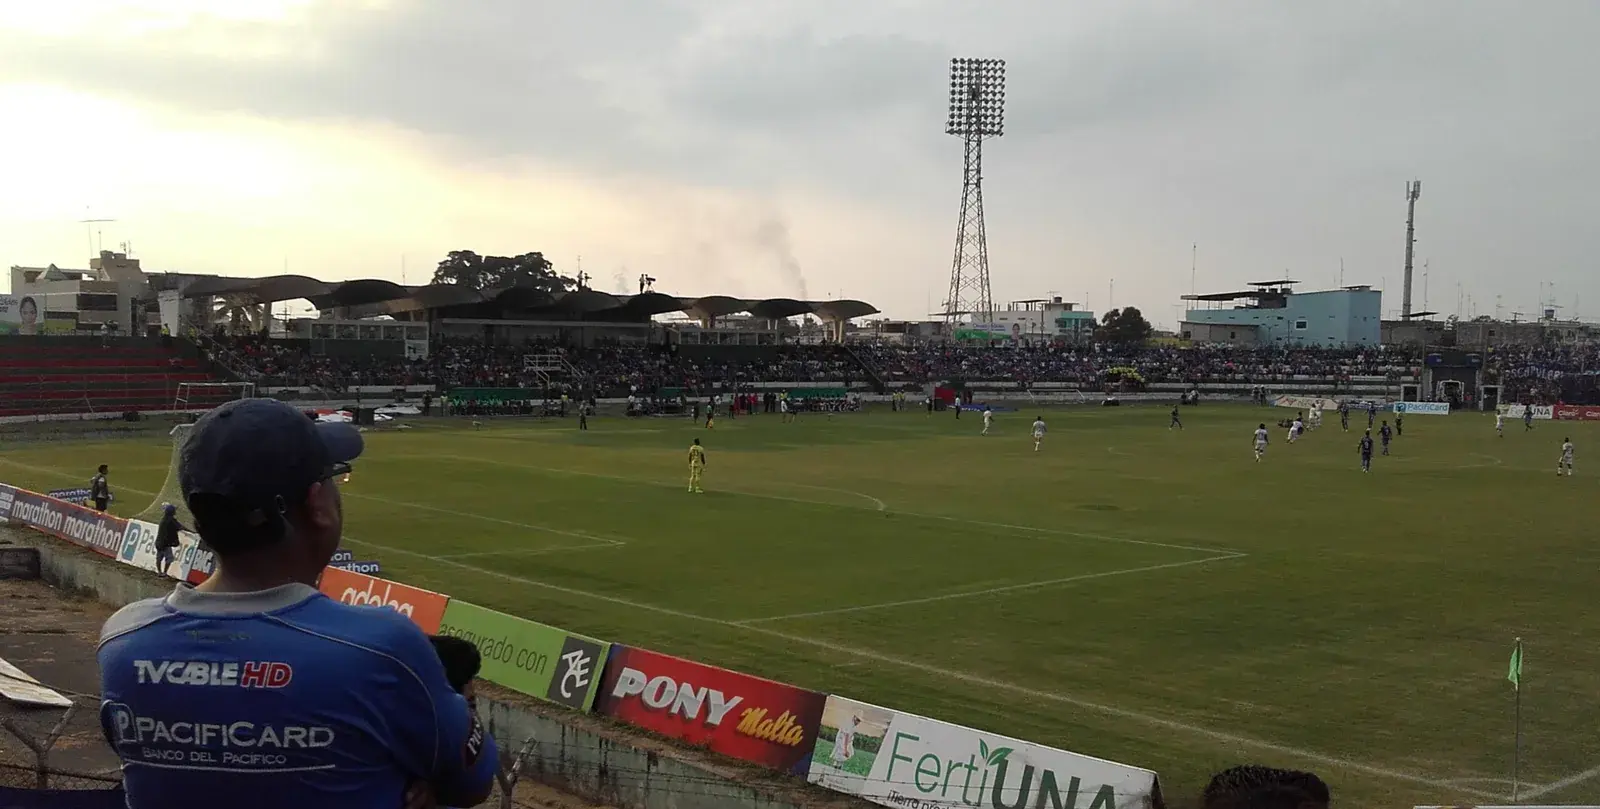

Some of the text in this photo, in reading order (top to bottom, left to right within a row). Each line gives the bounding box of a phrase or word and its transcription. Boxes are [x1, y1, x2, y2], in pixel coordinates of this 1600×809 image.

[1407, 403, 1448, 412] PacifiCard
[12, 498, 122, 556] marathon marathon
[240, 660, 293, 689] HD
[516, 648, 548, 675] con
[611, 666, 745, 727] PONY
[135, 716, 336, 749] PACIFICARD
[736, 706, 805, 746] Malta
[143, 747, 184, 761] BANCO
[189, 750, 218, 763] DEL
